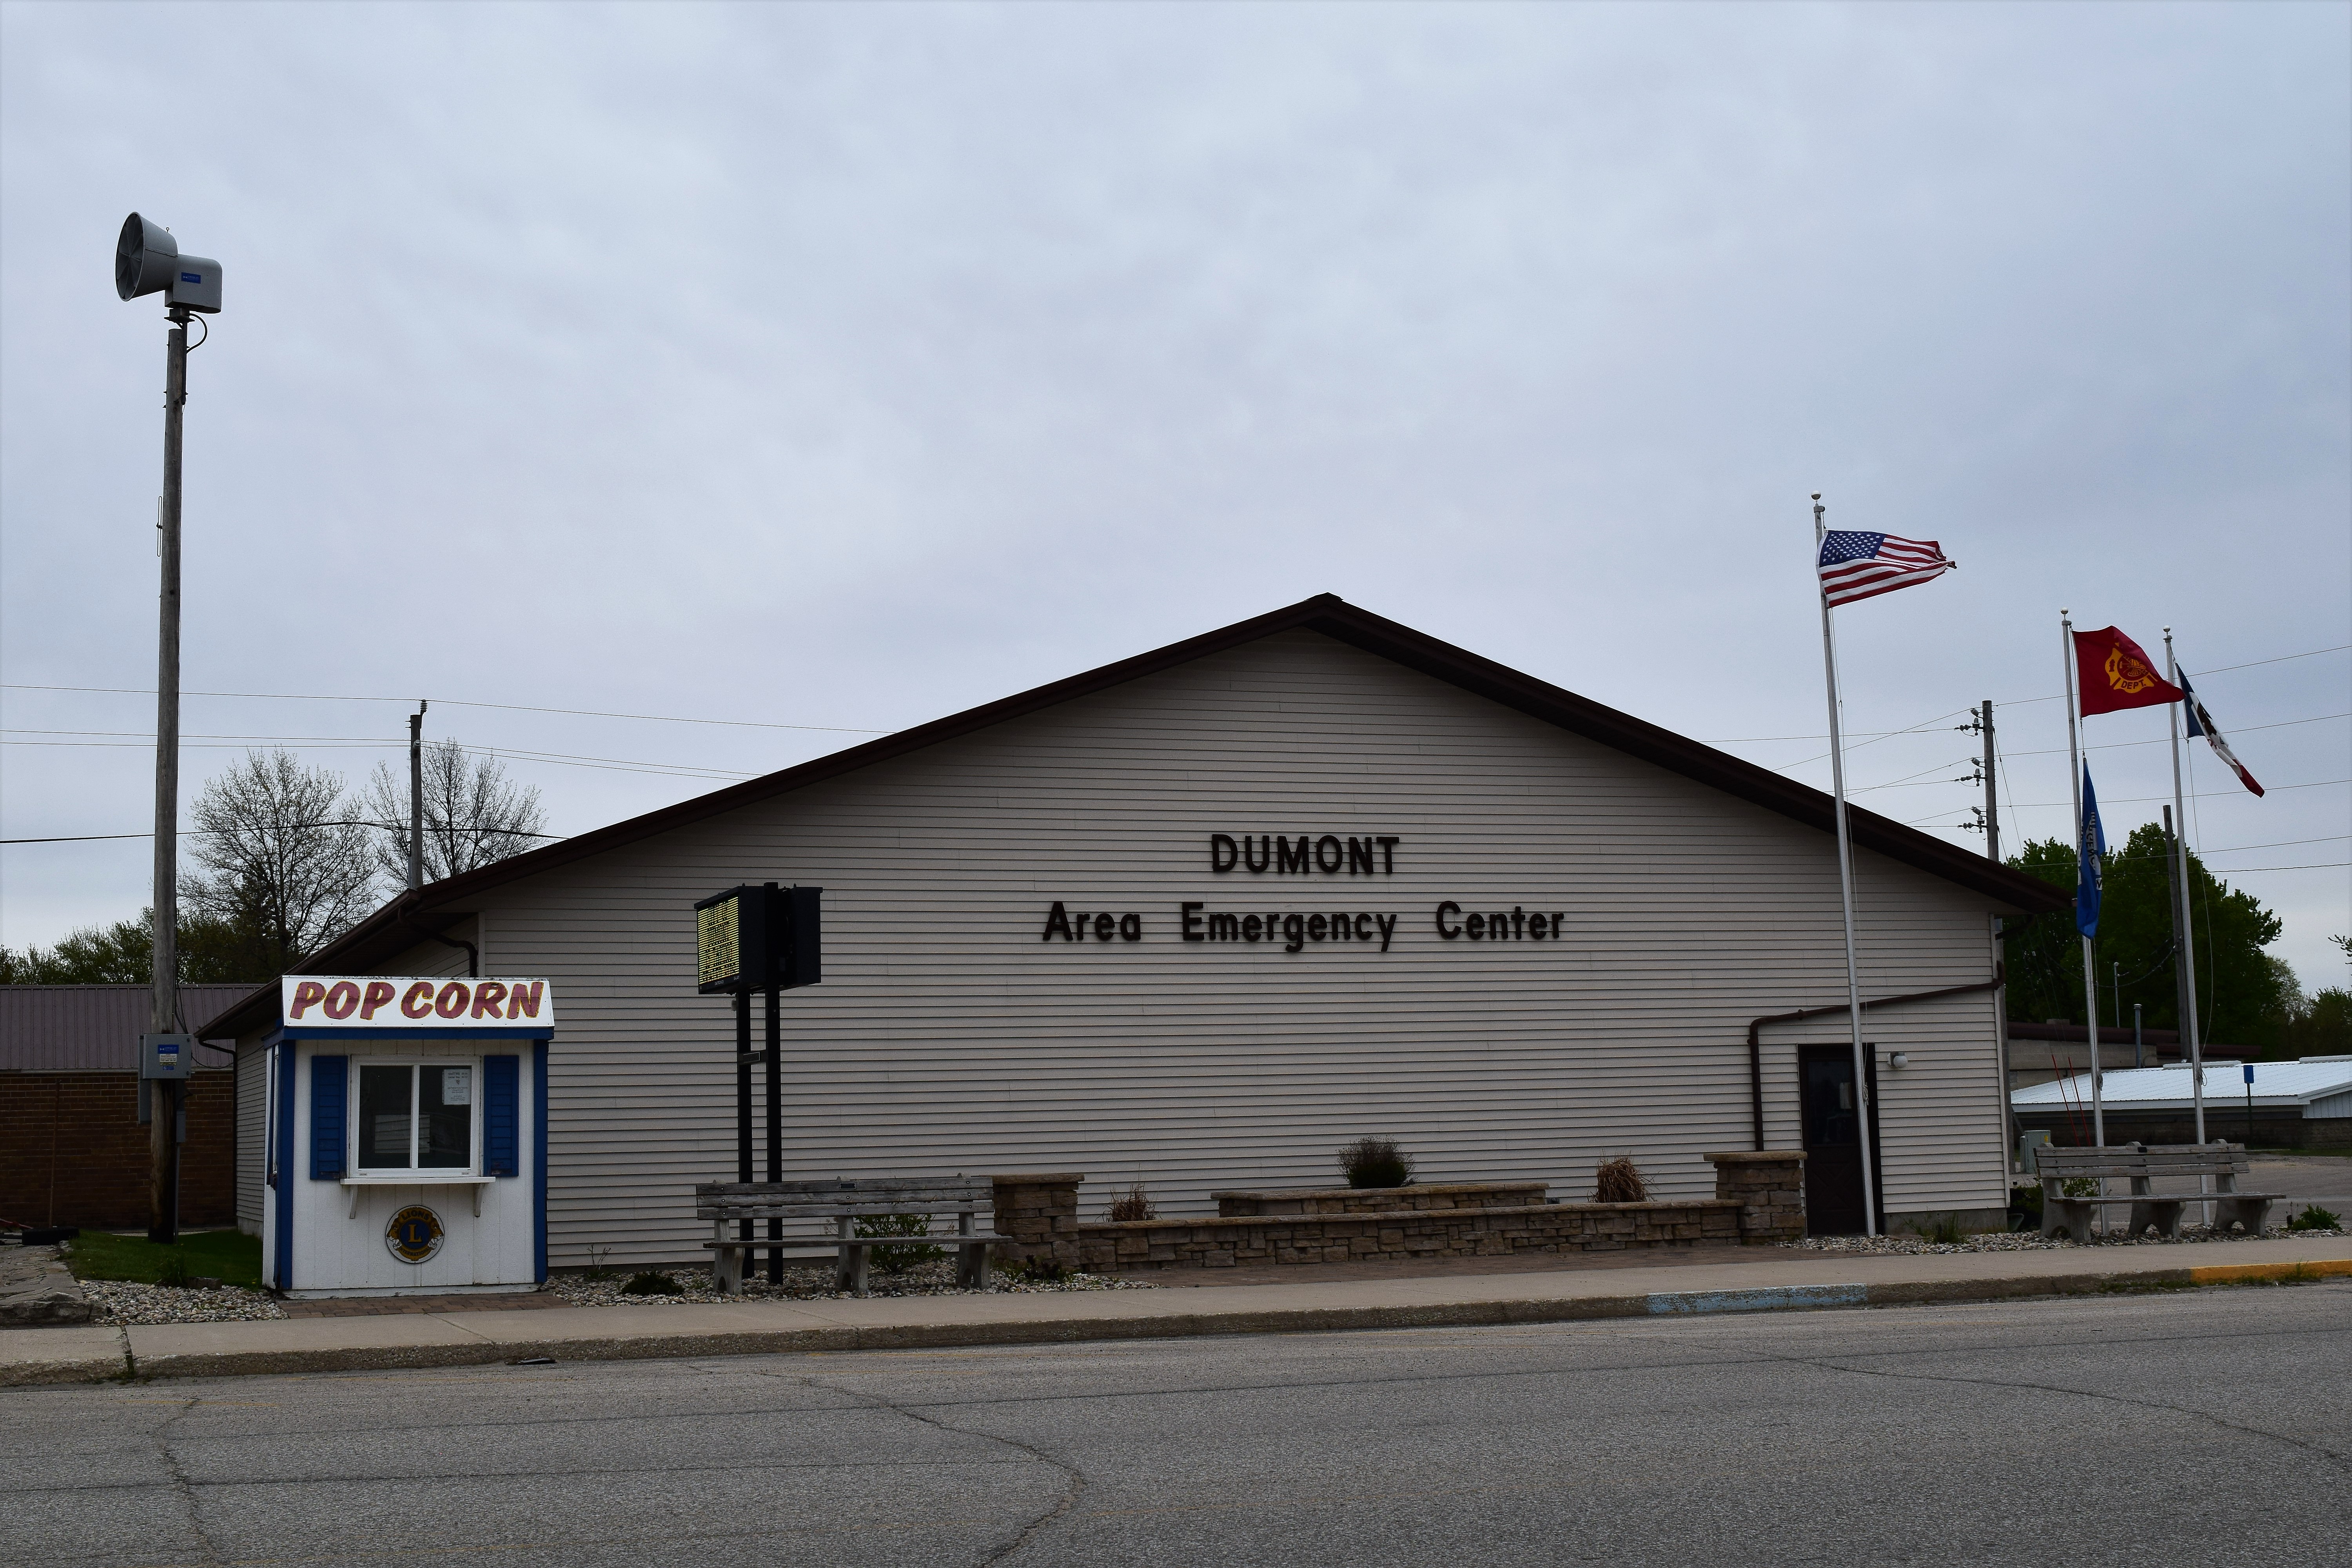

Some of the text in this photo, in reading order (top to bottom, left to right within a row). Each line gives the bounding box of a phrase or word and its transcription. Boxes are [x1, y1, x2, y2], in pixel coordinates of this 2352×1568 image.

[2121, 679, 2146, 689] DEPT.
[1211, 833, 1400, 875] DUMONT
[1042, 900, 1564, 954] Area Emergency Center
[401, 1210, 430, 1220] LIONS
[408, 1224, 422, 1242] L
